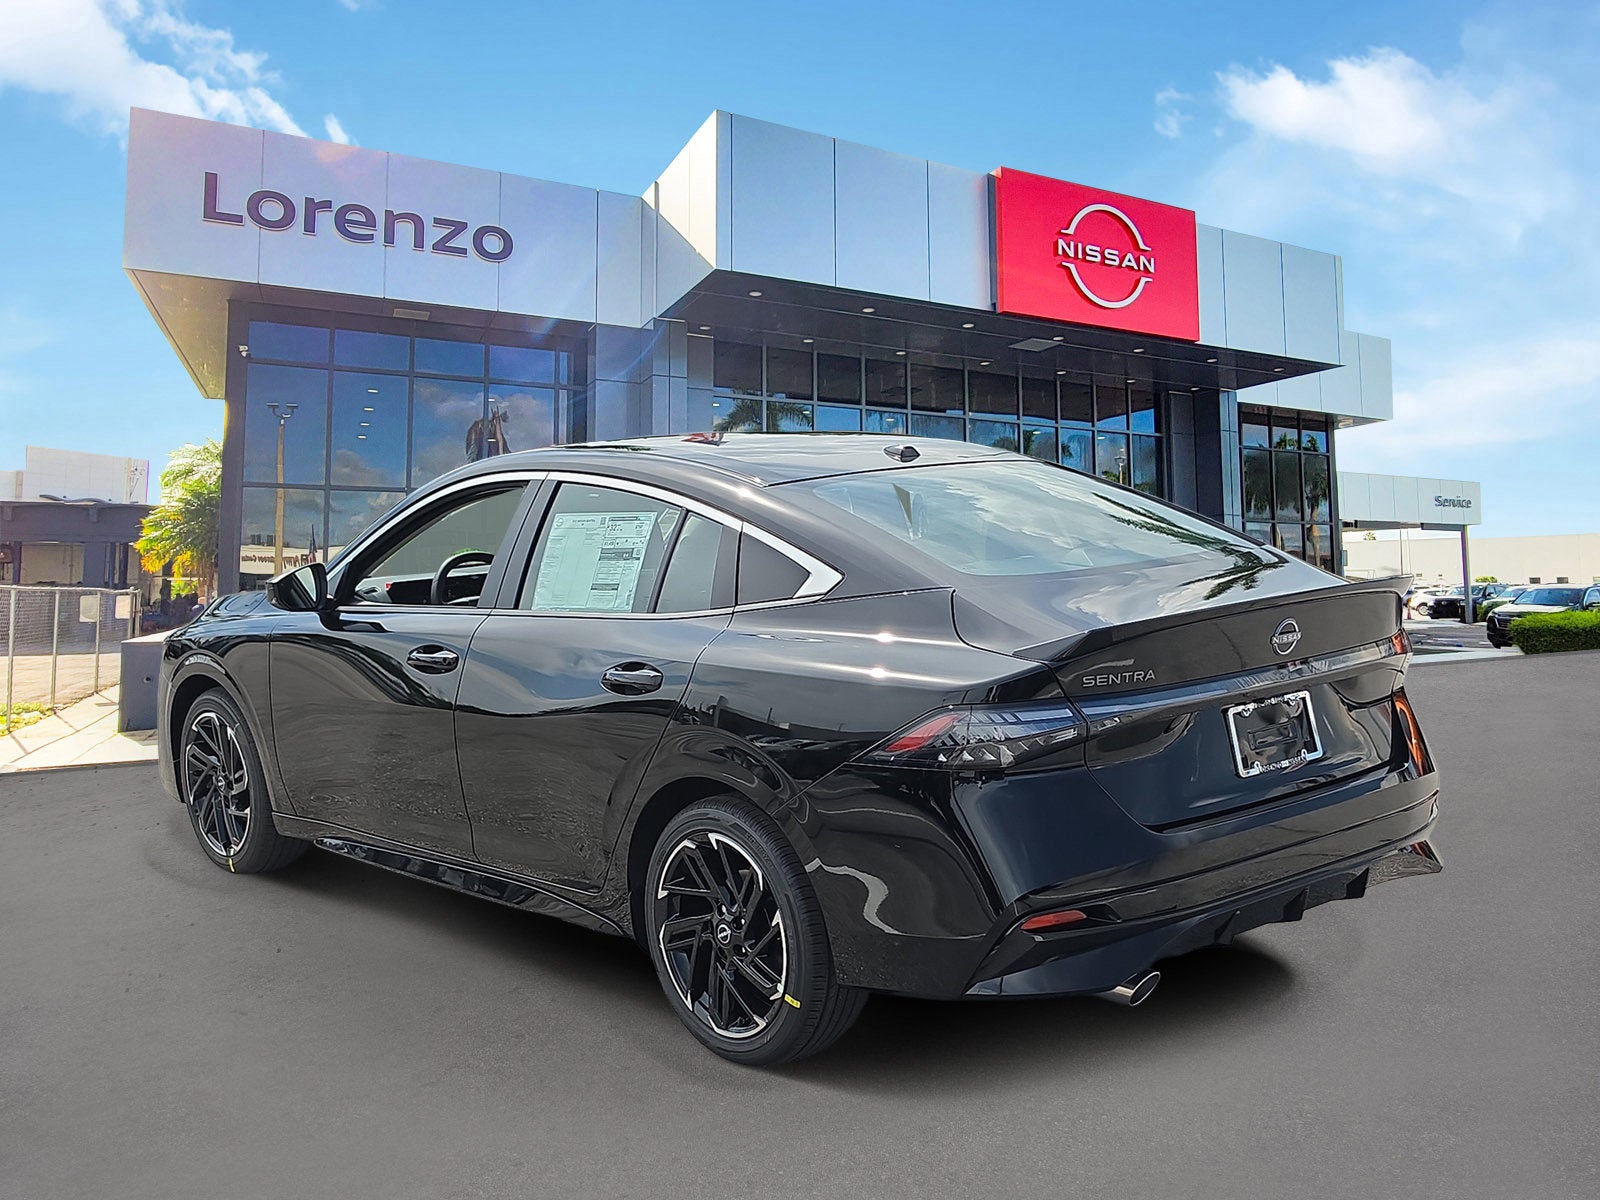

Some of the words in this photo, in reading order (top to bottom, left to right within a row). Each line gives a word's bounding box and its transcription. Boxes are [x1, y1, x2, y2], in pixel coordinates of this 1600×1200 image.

[202, 171, 514, 262] Lorenzo
[1058, 238, 1155, 273] NISSAN
[1434, 495, 1472, 508] Service
[1271, 632, 1301, 644] NISSAN
[1082, 670, 1156, 687] SENTRA
